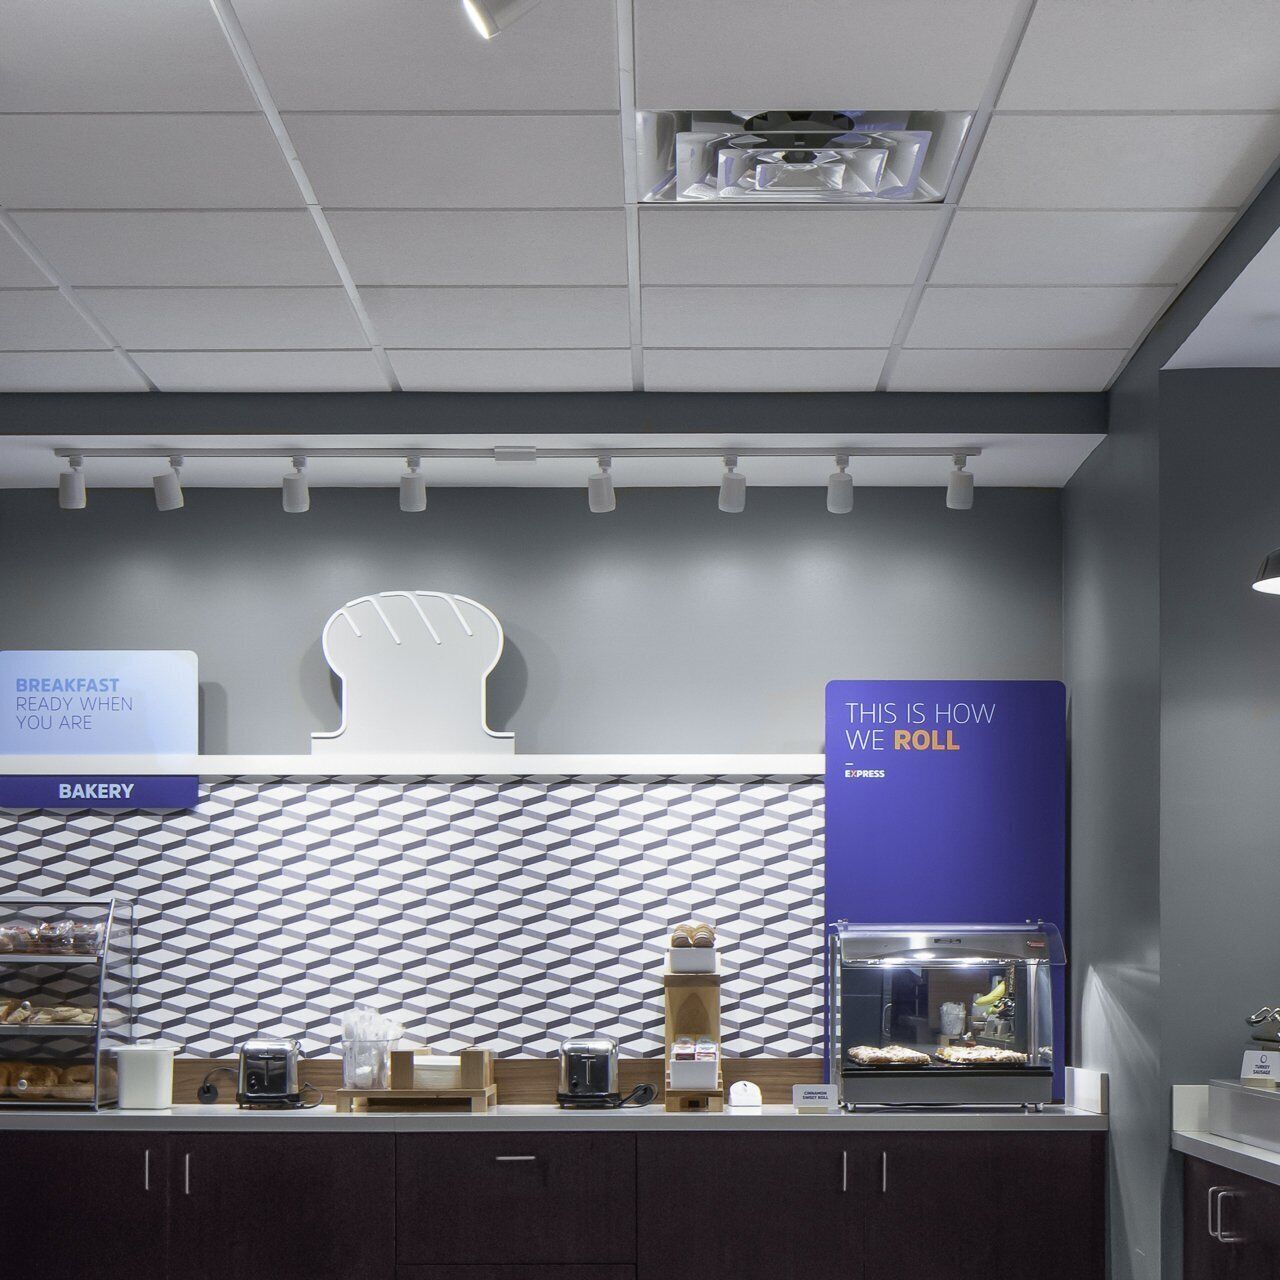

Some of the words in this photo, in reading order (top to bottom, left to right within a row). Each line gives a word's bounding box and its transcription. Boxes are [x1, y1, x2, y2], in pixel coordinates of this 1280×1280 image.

[16, 678, 119, 692] BREAKFAST
[16, 697, 73, 711] READY
[79, 697, 133, 711] WHEN
[845, 702, 897, 724] THIS
[907, 702, 926, 724] IS
[935, 702, 996, 724] HOW
[15, 715, 52, 730] YOU
[58, 715, 93, 730] ARE
[845, 729, 885, 751] WE
[894, 729, 960, 751] ROLL
[844, 769, 885, 778] EXPRESS
[59, 783, 135, 799] BAKERY
